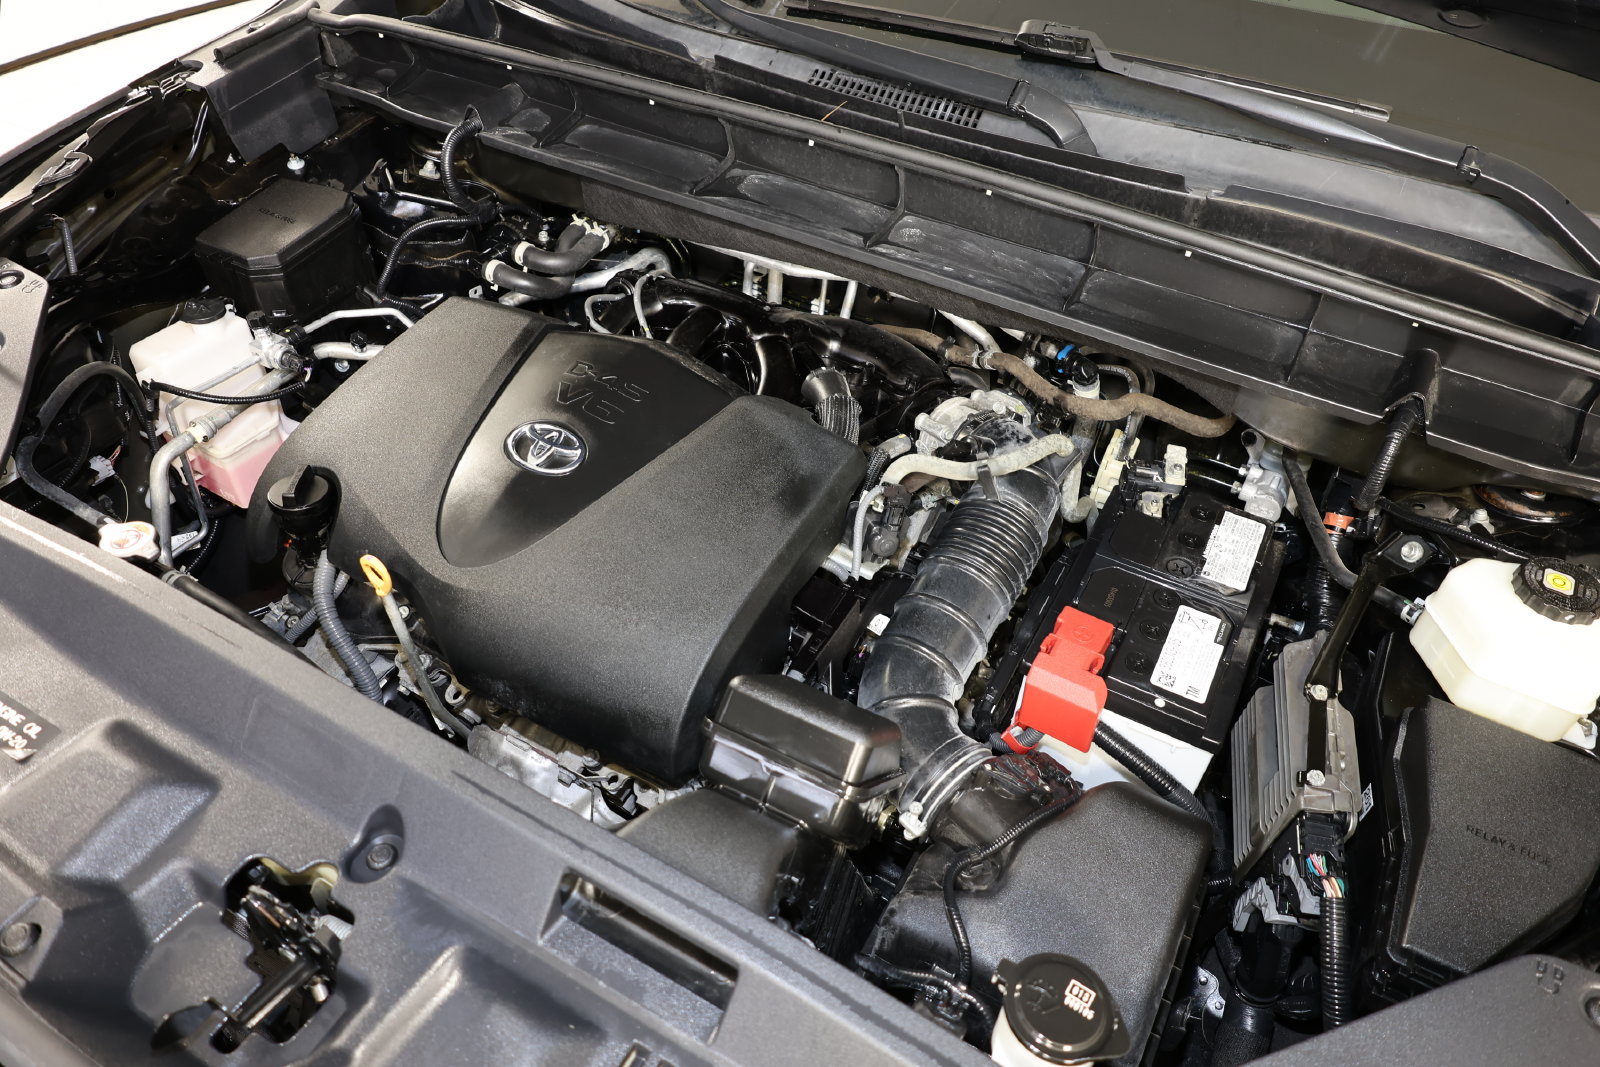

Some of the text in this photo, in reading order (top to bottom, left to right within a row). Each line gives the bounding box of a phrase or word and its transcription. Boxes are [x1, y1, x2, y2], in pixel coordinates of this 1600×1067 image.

[556, 381, 625, 425] V6
[23, 722, 42, 739] OIL
[1466, 825, 1507, 847] RELAY
[1508, 842, 1516, 852] &
